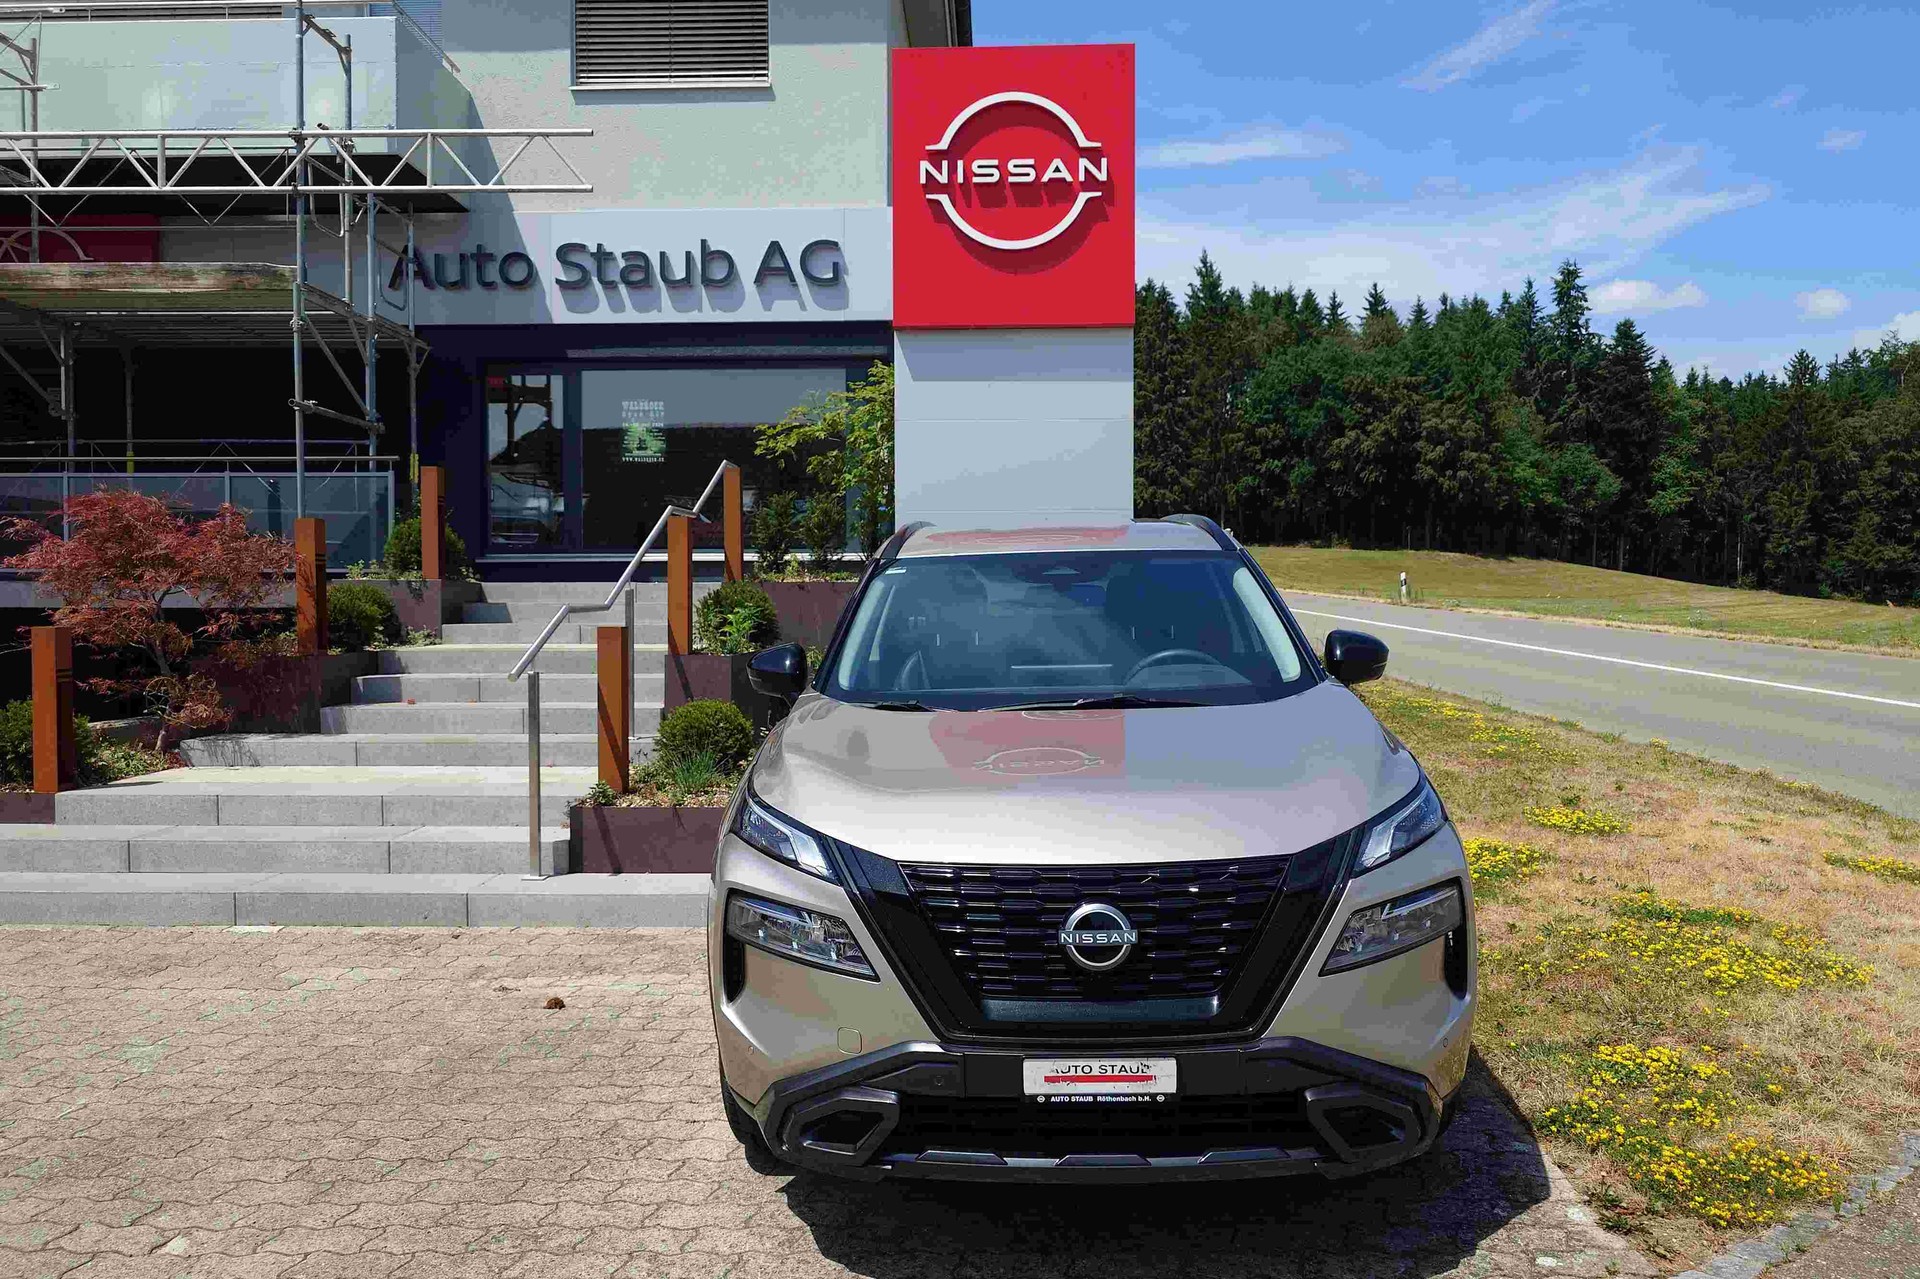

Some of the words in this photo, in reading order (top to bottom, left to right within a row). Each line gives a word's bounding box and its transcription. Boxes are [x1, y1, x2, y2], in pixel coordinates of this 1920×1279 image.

[919, 157, 1108, 185] NISSAN
[388, 242, 536, 290] Auto
[555, 239, 735, 288] Staub
[753, 239, 842, 287] AG
[1061, 932, 1136, 944] NISSAN
